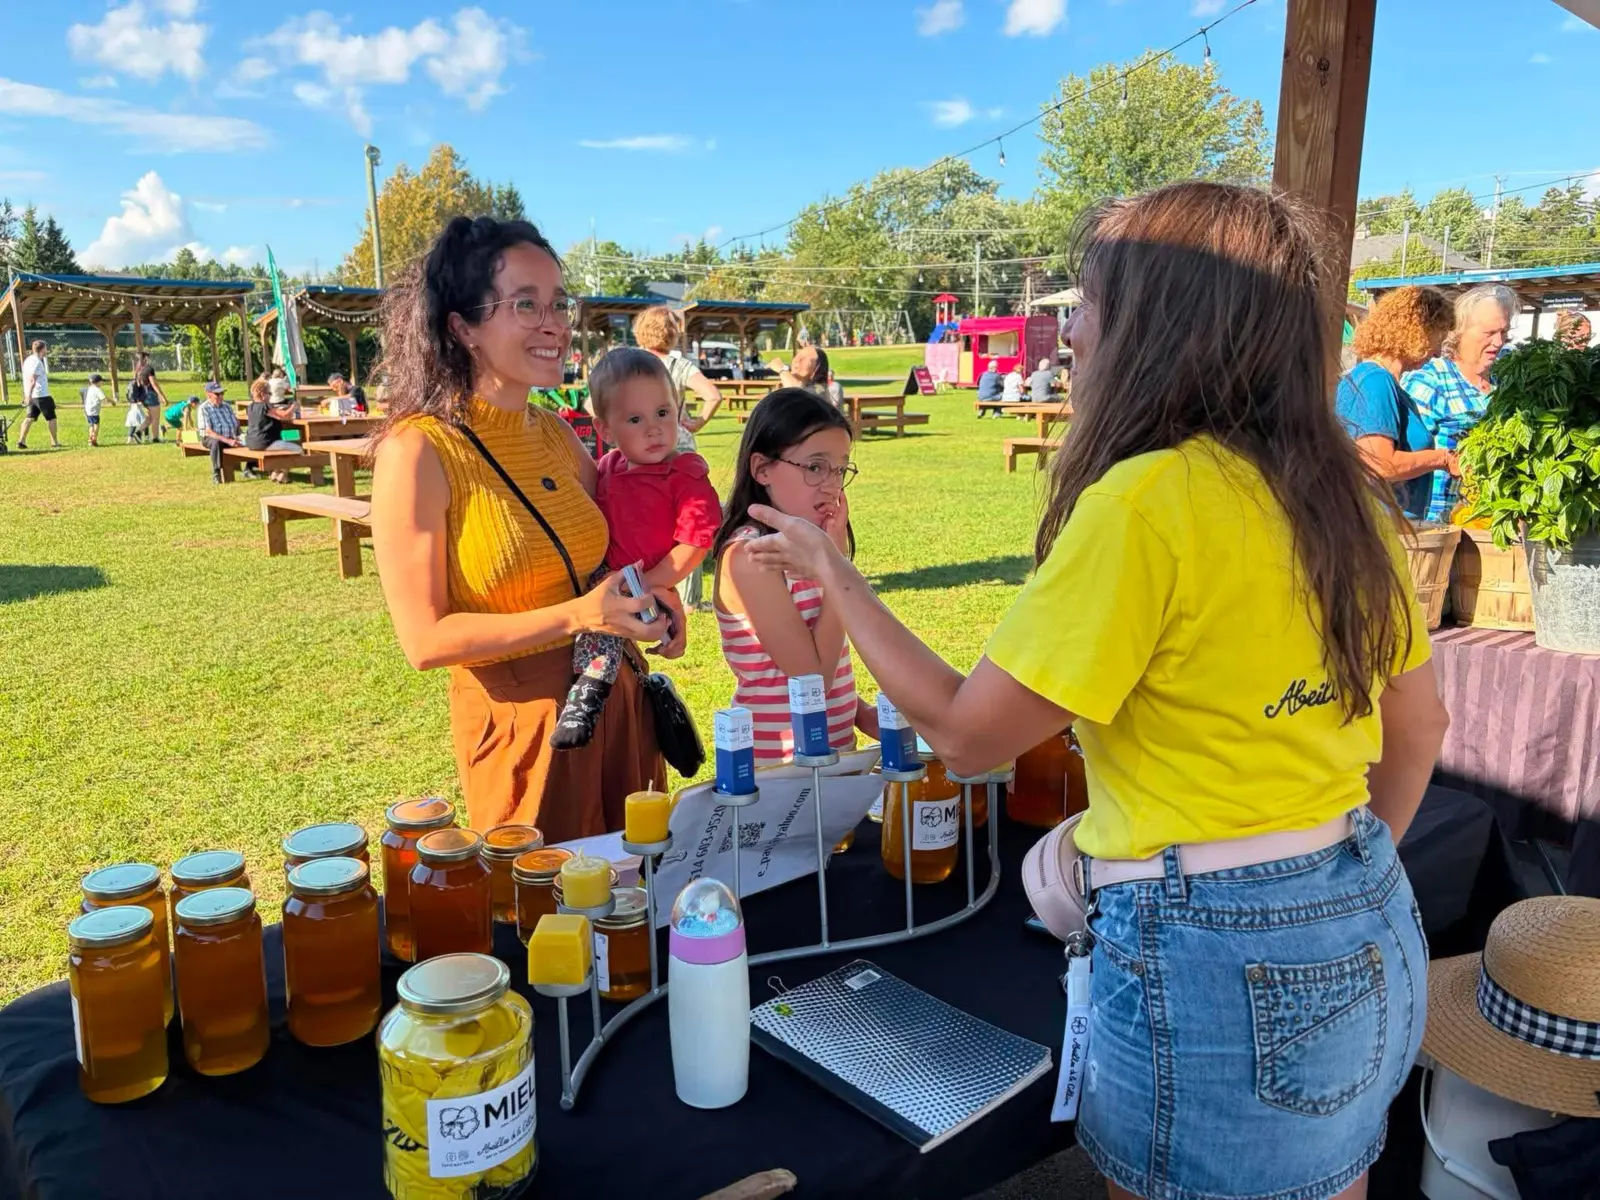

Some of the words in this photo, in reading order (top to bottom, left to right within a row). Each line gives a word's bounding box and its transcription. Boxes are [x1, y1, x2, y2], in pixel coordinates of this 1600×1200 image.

[688, 859, 704, 884] 514
[696, 805, 727, 858] 603-9520
[484, 1076, 535, 1129] MIEL
